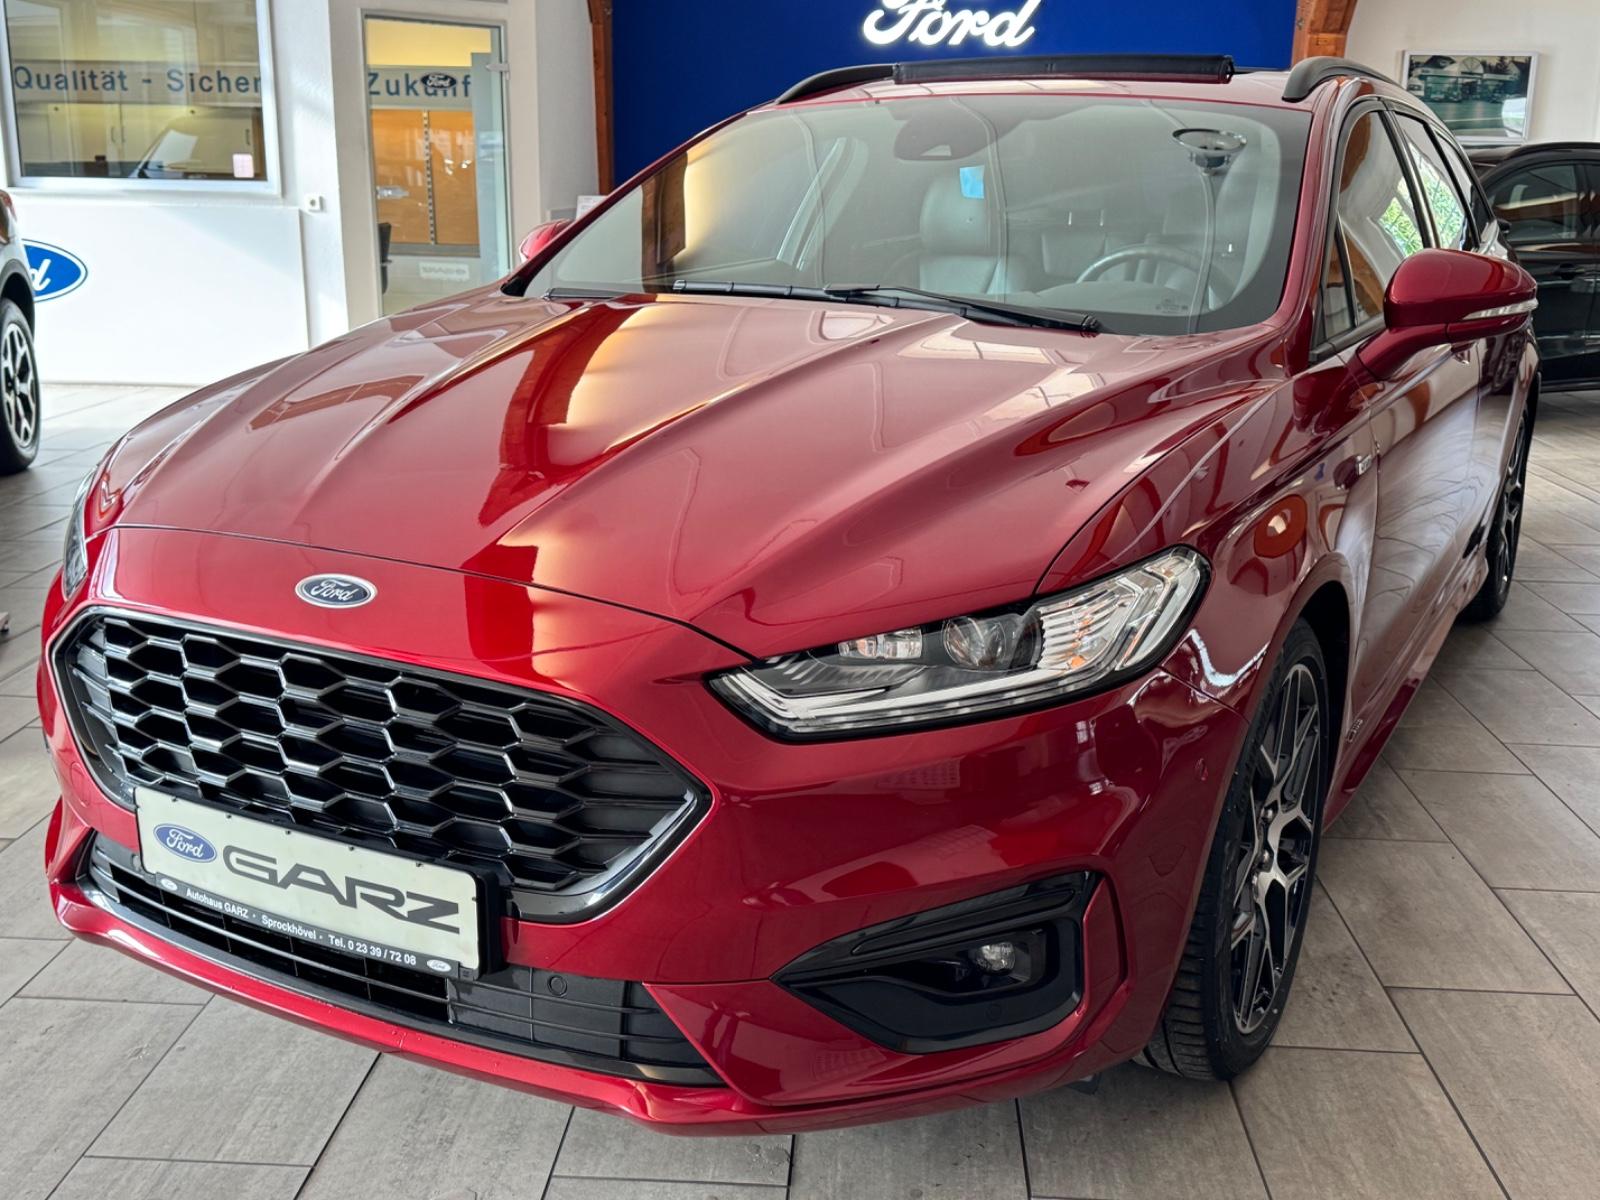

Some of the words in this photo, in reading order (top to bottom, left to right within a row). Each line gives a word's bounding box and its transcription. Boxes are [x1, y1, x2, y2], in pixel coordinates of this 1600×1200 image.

[863, 0, 1042, 47] Ford
[14, 65, 128, 92] Qualität
[310, 579, 359, 601] Ford
[166, 828, 204, 858] Ford
[222, 844, 460, 935] GARZ
[186, 888, 224, 911] Autohaus
[224, 902, 249, 919] GARZ
[261, 914, 317, 941] Sprockhövel
[328, 934, 346, 948] Tel.
[348, 940, 354, 950] 0
[356, 942, 368, 953] 23
[369, 945, 382, 957] 39
[390, 950, 402, 962] 72
[404, 953, 416, 965] 08
